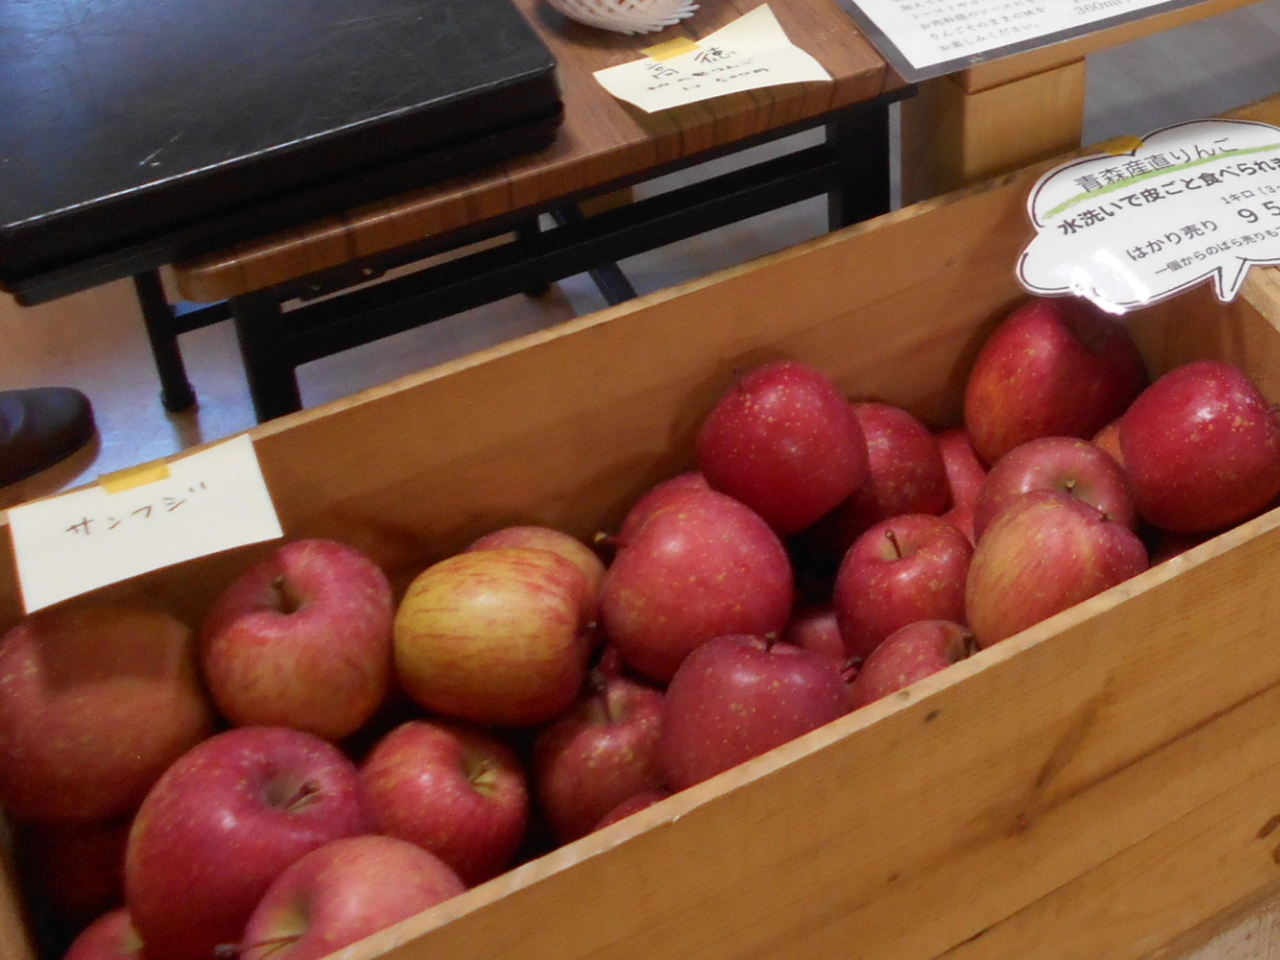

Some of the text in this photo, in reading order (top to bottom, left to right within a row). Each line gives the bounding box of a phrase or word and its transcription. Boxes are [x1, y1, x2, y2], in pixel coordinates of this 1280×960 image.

[1074, 137, 1239, 192] 青森産直りんご
[1125, 219, 1218, 261] はかり売り
[65, 481, 207, 536] サンフジ
